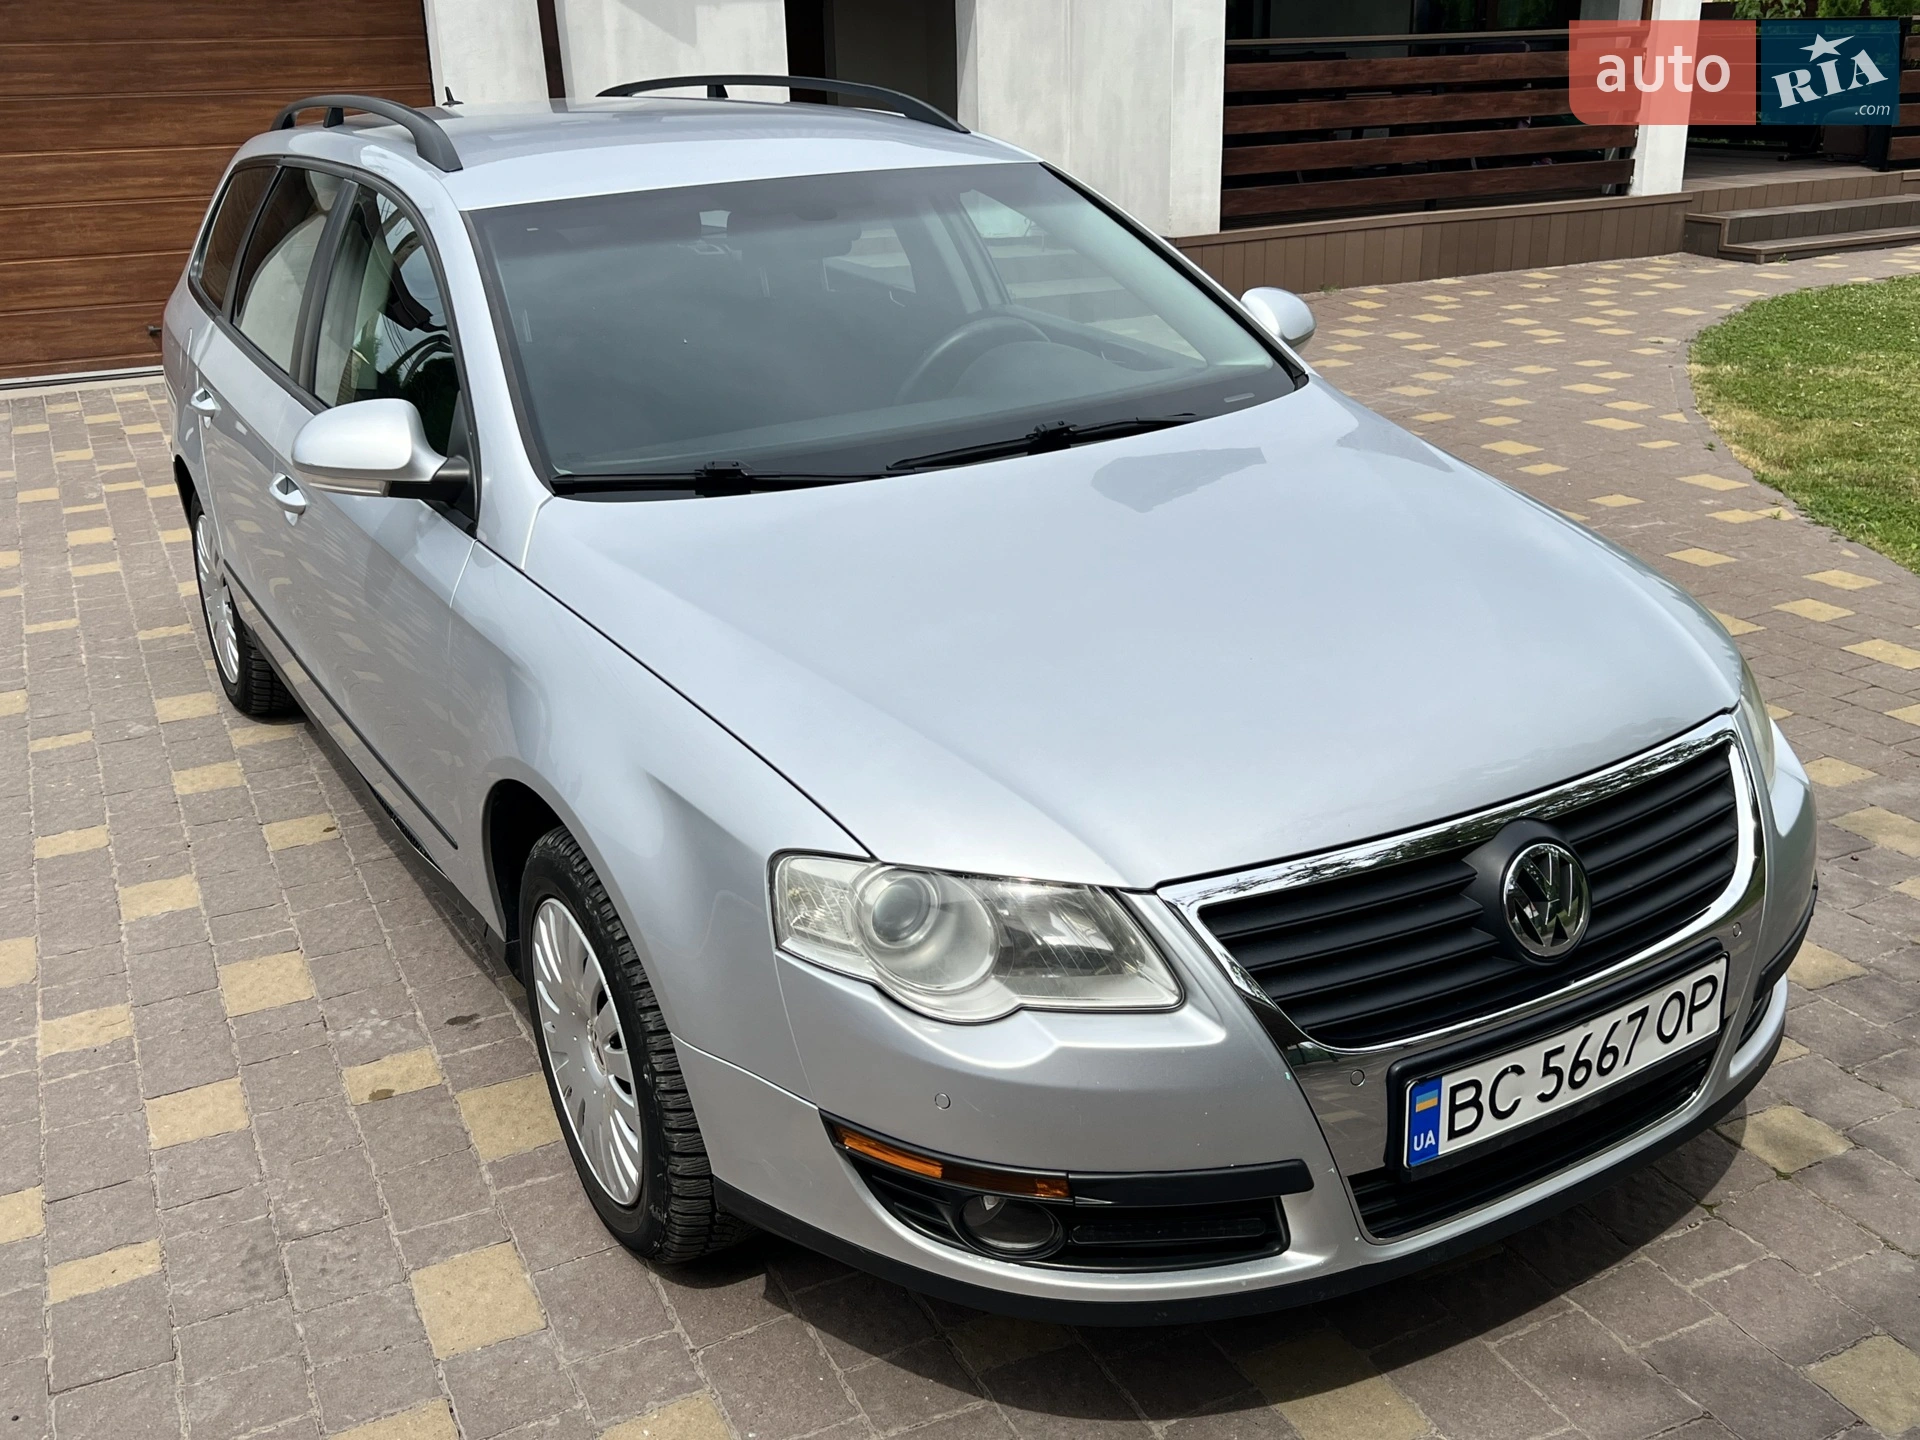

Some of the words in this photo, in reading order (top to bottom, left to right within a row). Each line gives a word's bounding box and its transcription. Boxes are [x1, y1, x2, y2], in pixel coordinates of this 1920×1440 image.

[1447, 1064, 1526, 1141] BC
[1536, 1004, 1650, 1103] 5667
[1655, 974, 1719, 1044] OP
[1413, 1129, 1437, 1152] UA
